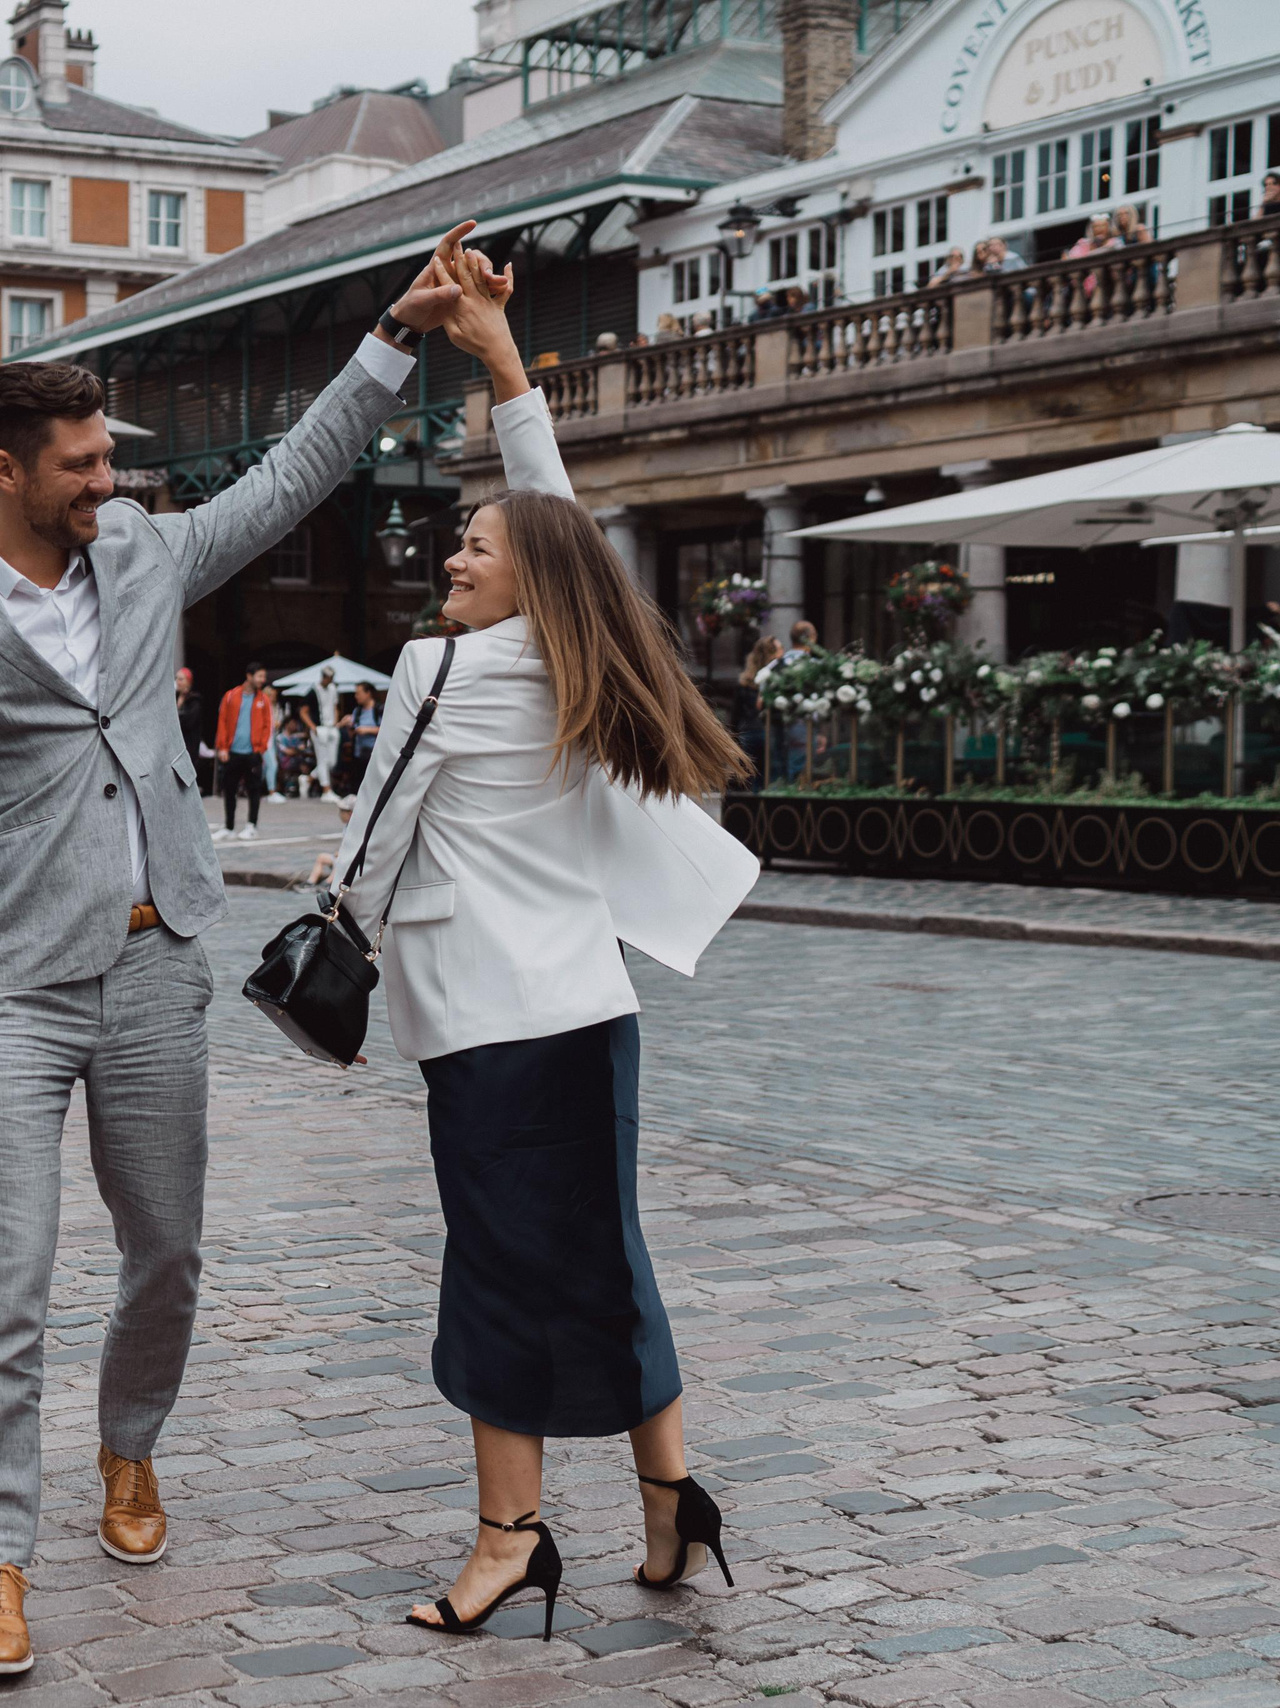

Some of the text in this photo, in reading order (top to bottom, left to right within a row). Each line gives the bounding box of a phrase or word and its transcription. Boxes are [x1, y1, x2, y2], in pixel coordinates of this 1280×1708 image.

[1025, 11, 1125, 66] PUNCH
[1024, 54, 1123, 107] & JUDY
